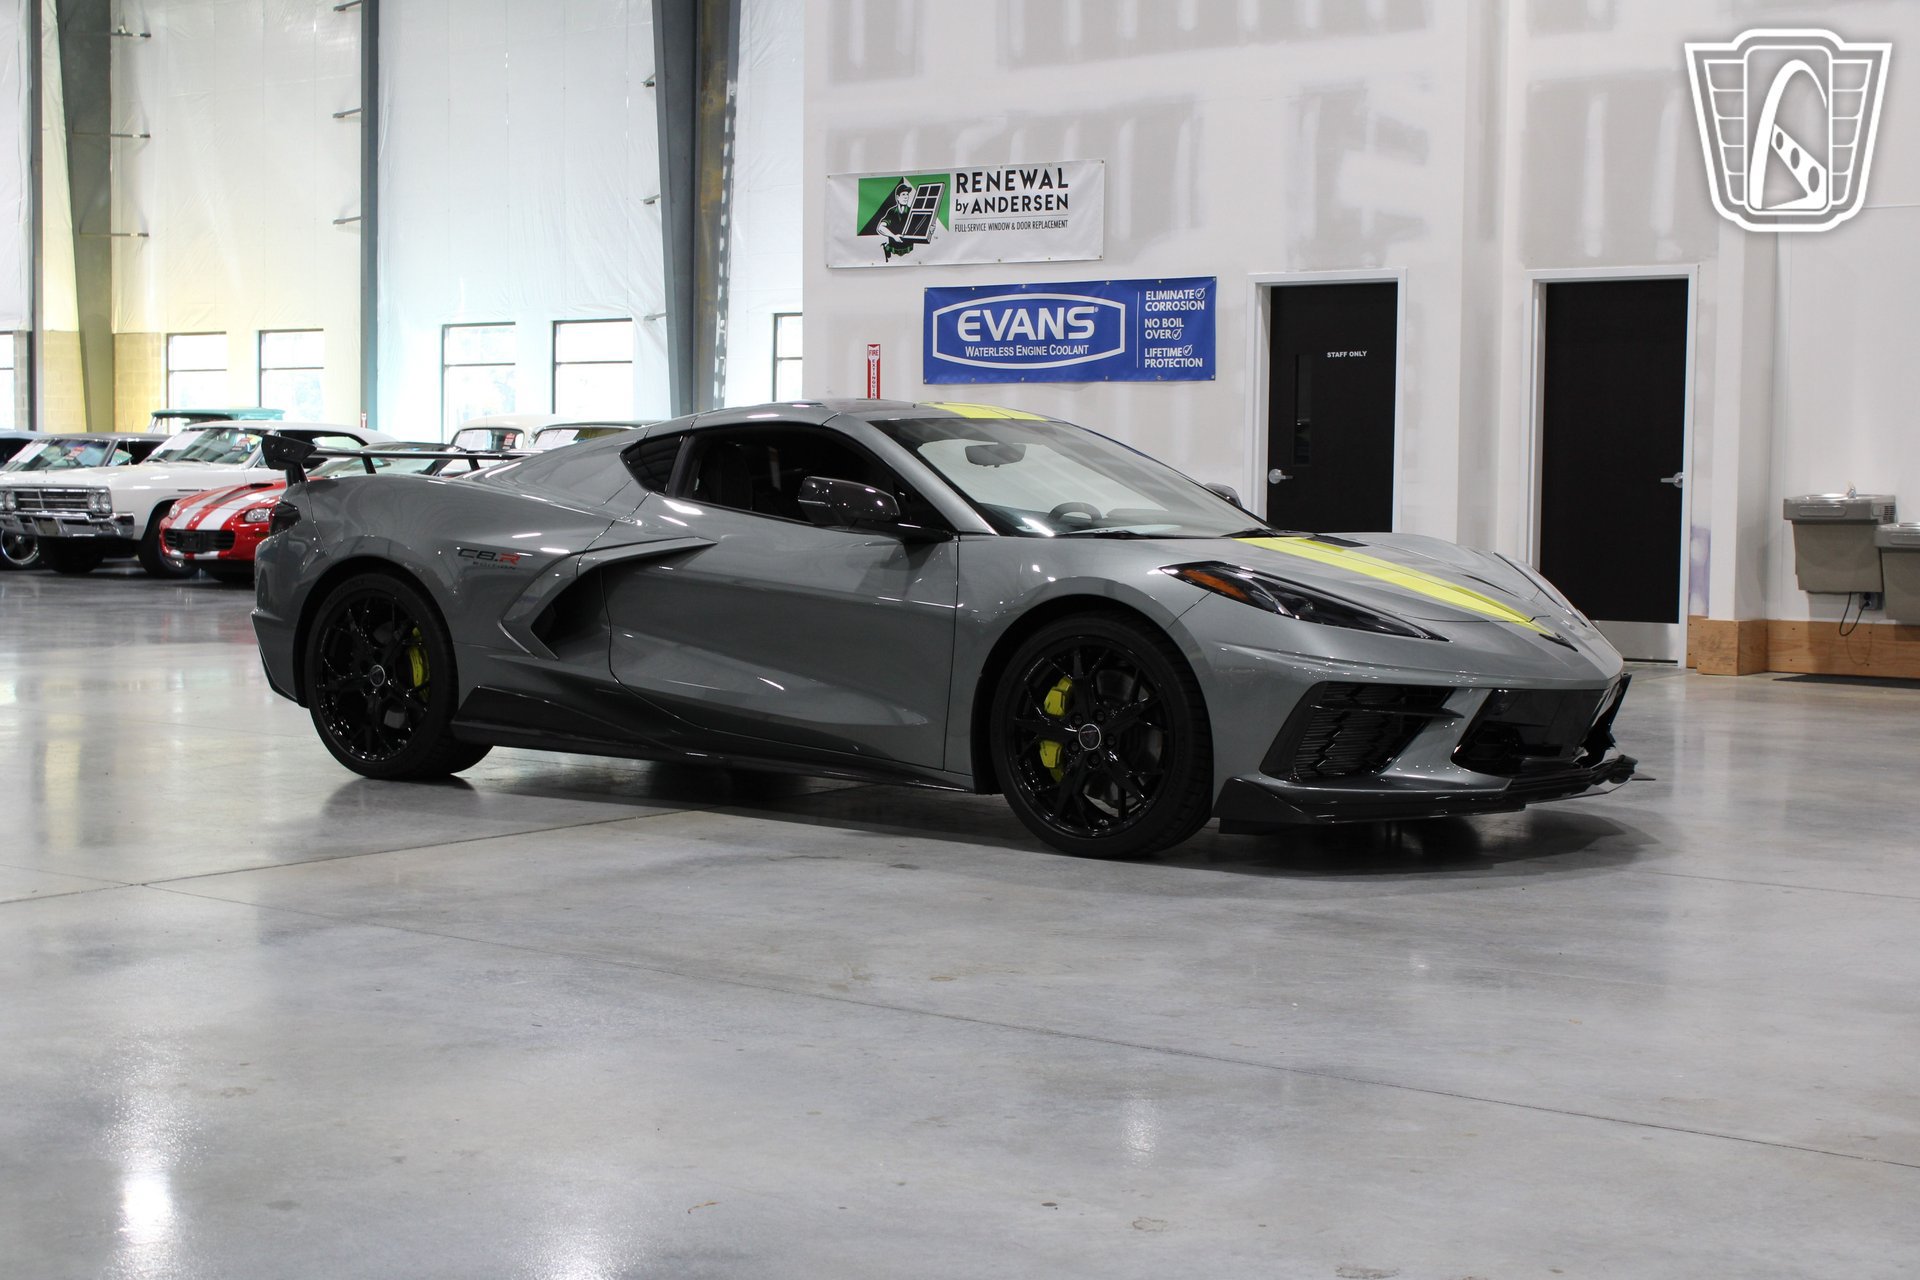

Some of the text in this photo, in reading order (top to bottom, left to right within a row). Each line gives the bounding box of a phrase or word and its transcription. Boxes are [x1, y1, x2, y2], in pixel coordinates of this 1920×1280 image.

[956, 168, 1069, 194] RENEWAL
[955, 193, 1069, 214] by ANDERSEN
[954, 222, 987, 232] FULL-SERVICE
[988, 221, 1010, 231] WINDOW
[1016, 221, 1032, 231] DOOR
[1032, 219, 1069, 230] REPLACEMENT
[1145, 289, 1195, 301] ELIMINATE
[1145, 300, 1205, 312] CORROSION
[957, 306, 1096, 342] EVANS
[1144, 317, 1185, 328] NO BOIL
[1145, 329, 1172, 340] OVER
[1144, 347, 1183, 357] LIFETIME
[1144, 358, 1203, 368] PROTECTION
